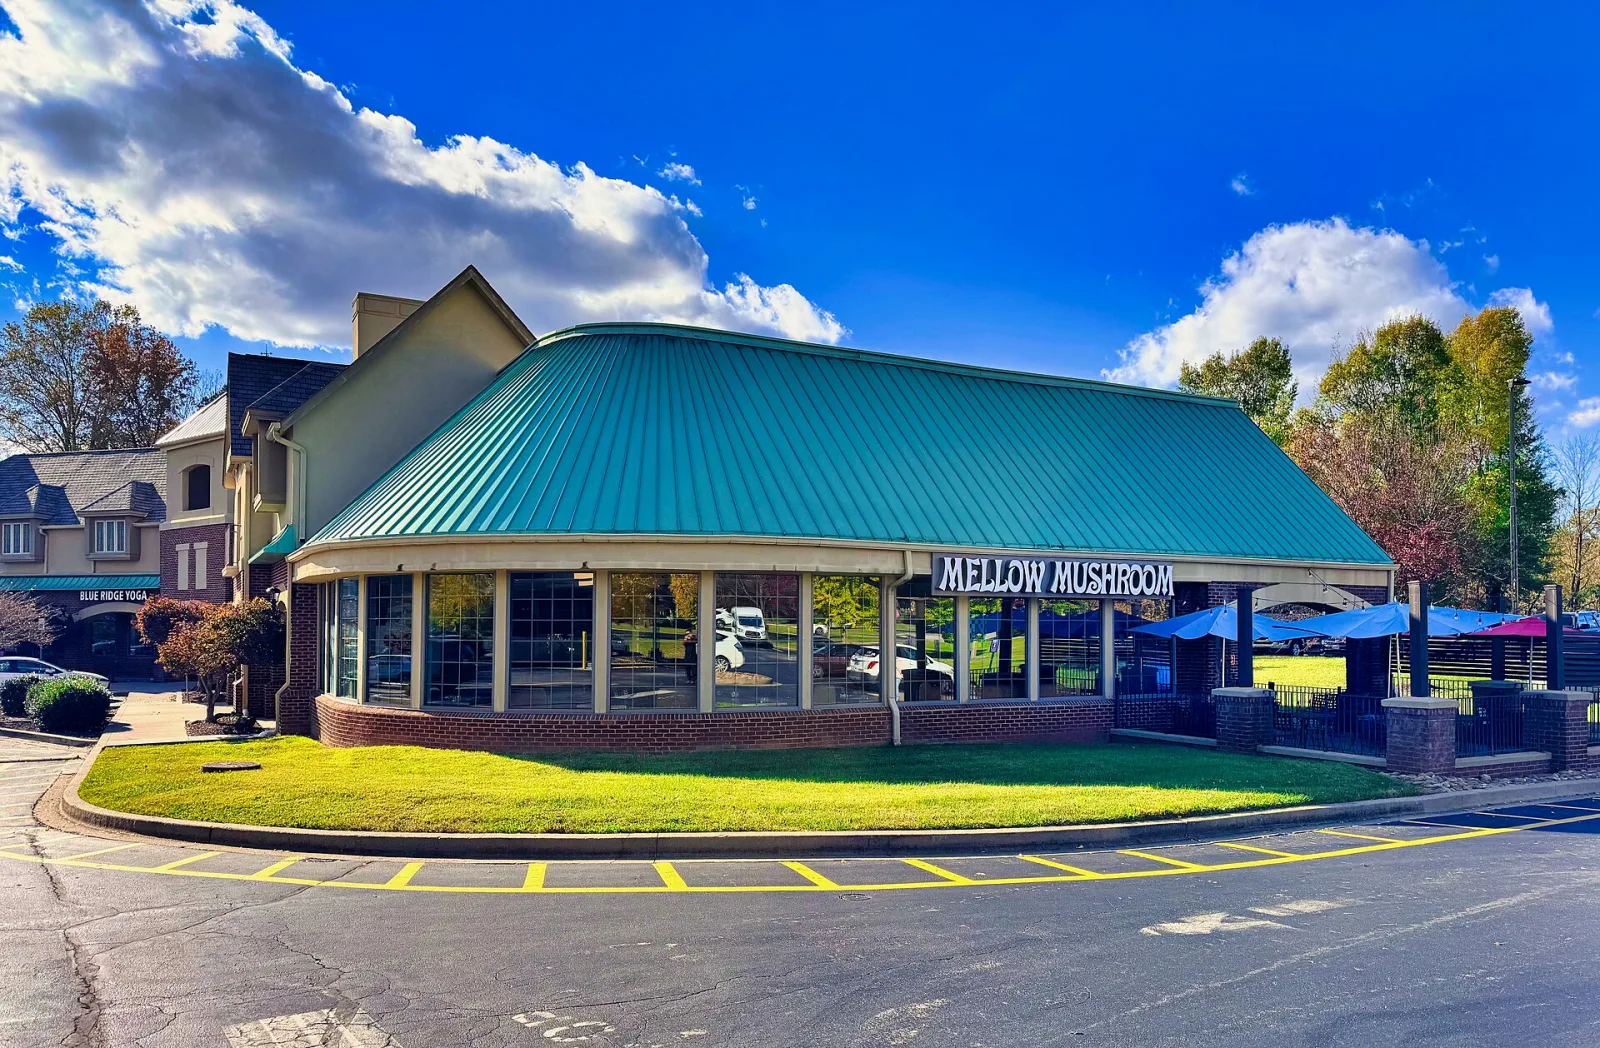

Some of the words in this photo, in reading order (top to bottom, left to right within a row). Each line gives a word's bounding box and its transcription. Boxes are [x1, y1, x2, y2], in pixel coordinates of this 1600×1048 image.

[938, 556, 1046, 593] MELLOW
[1050, 560, 1174, 597] MUSHROOM
[80, 590, 99, 601] BLUE
[101, 590, 124, 601] RIDGE
[125, 590, 147, 601] YOGA
